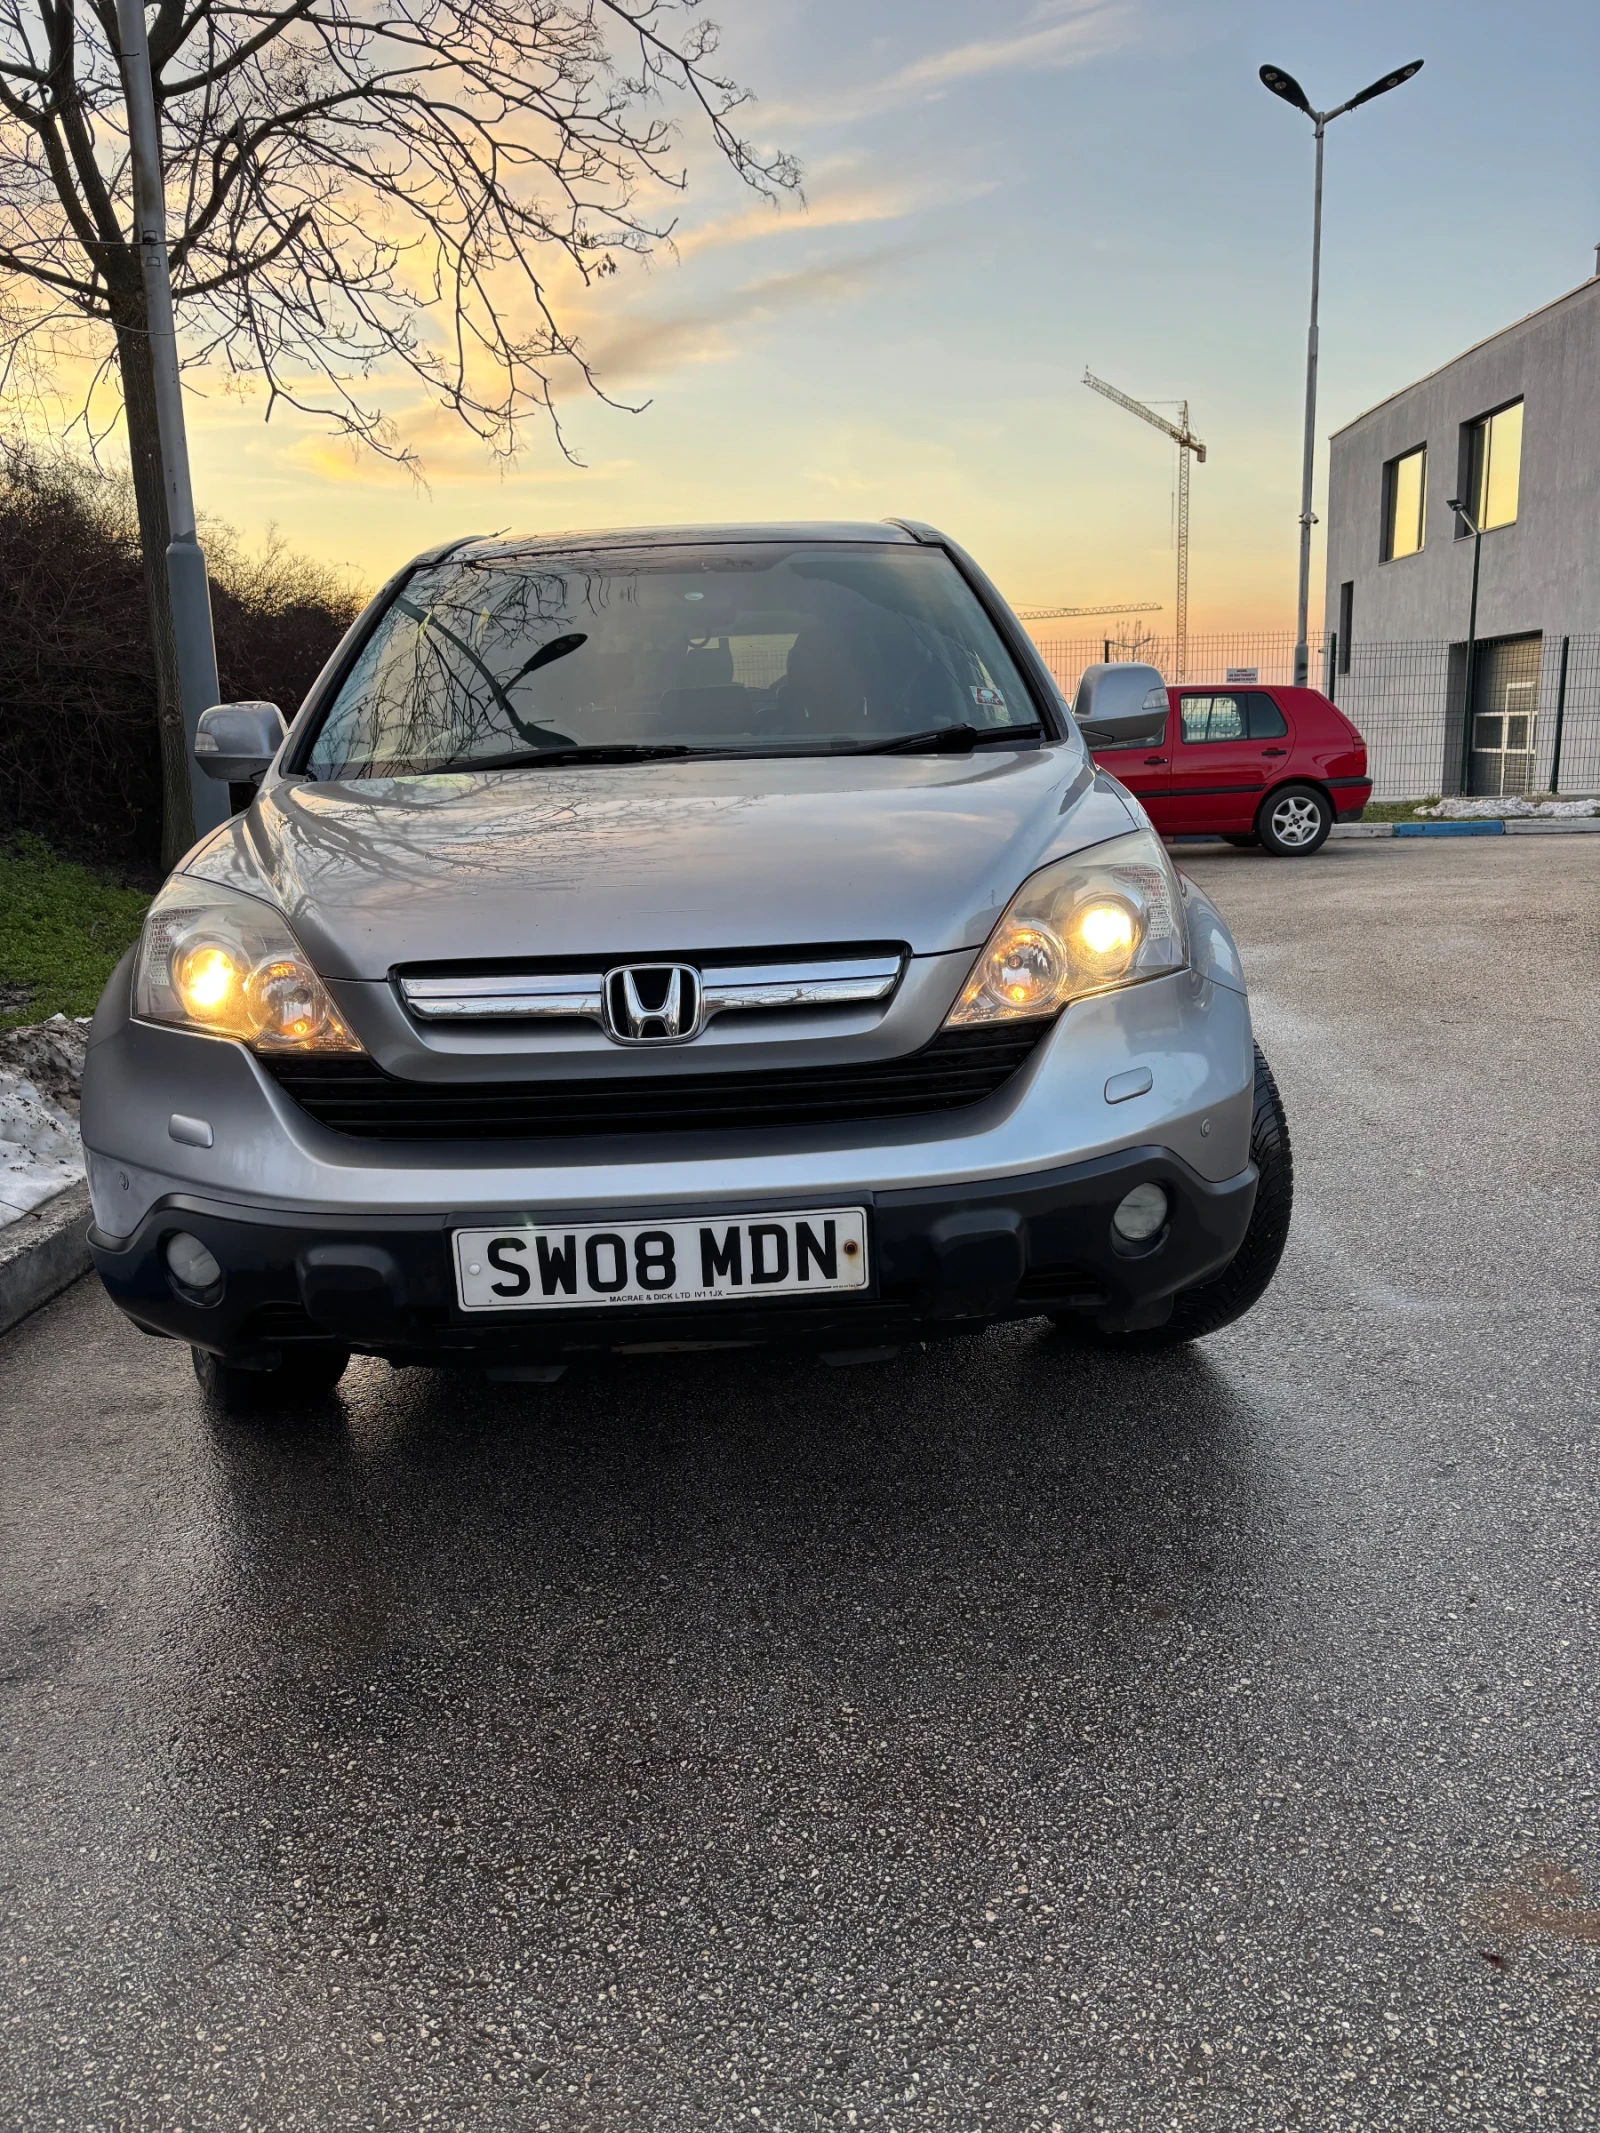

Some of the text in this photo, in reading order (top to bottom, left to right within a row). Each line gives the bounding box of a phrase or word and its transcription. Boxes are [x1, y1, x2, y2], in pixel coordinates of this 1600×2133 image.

[487, 1219, 838, 1297] SW08 MDN
[609, 1294, 644, 1302] MACRAE
[654, 1293, 673, 1301] DICK
[675, 1291, 691, 1299] LTD
[694, 1290, 706, 1298] IV1
[709, 1289, 723, 1297] 1JX
